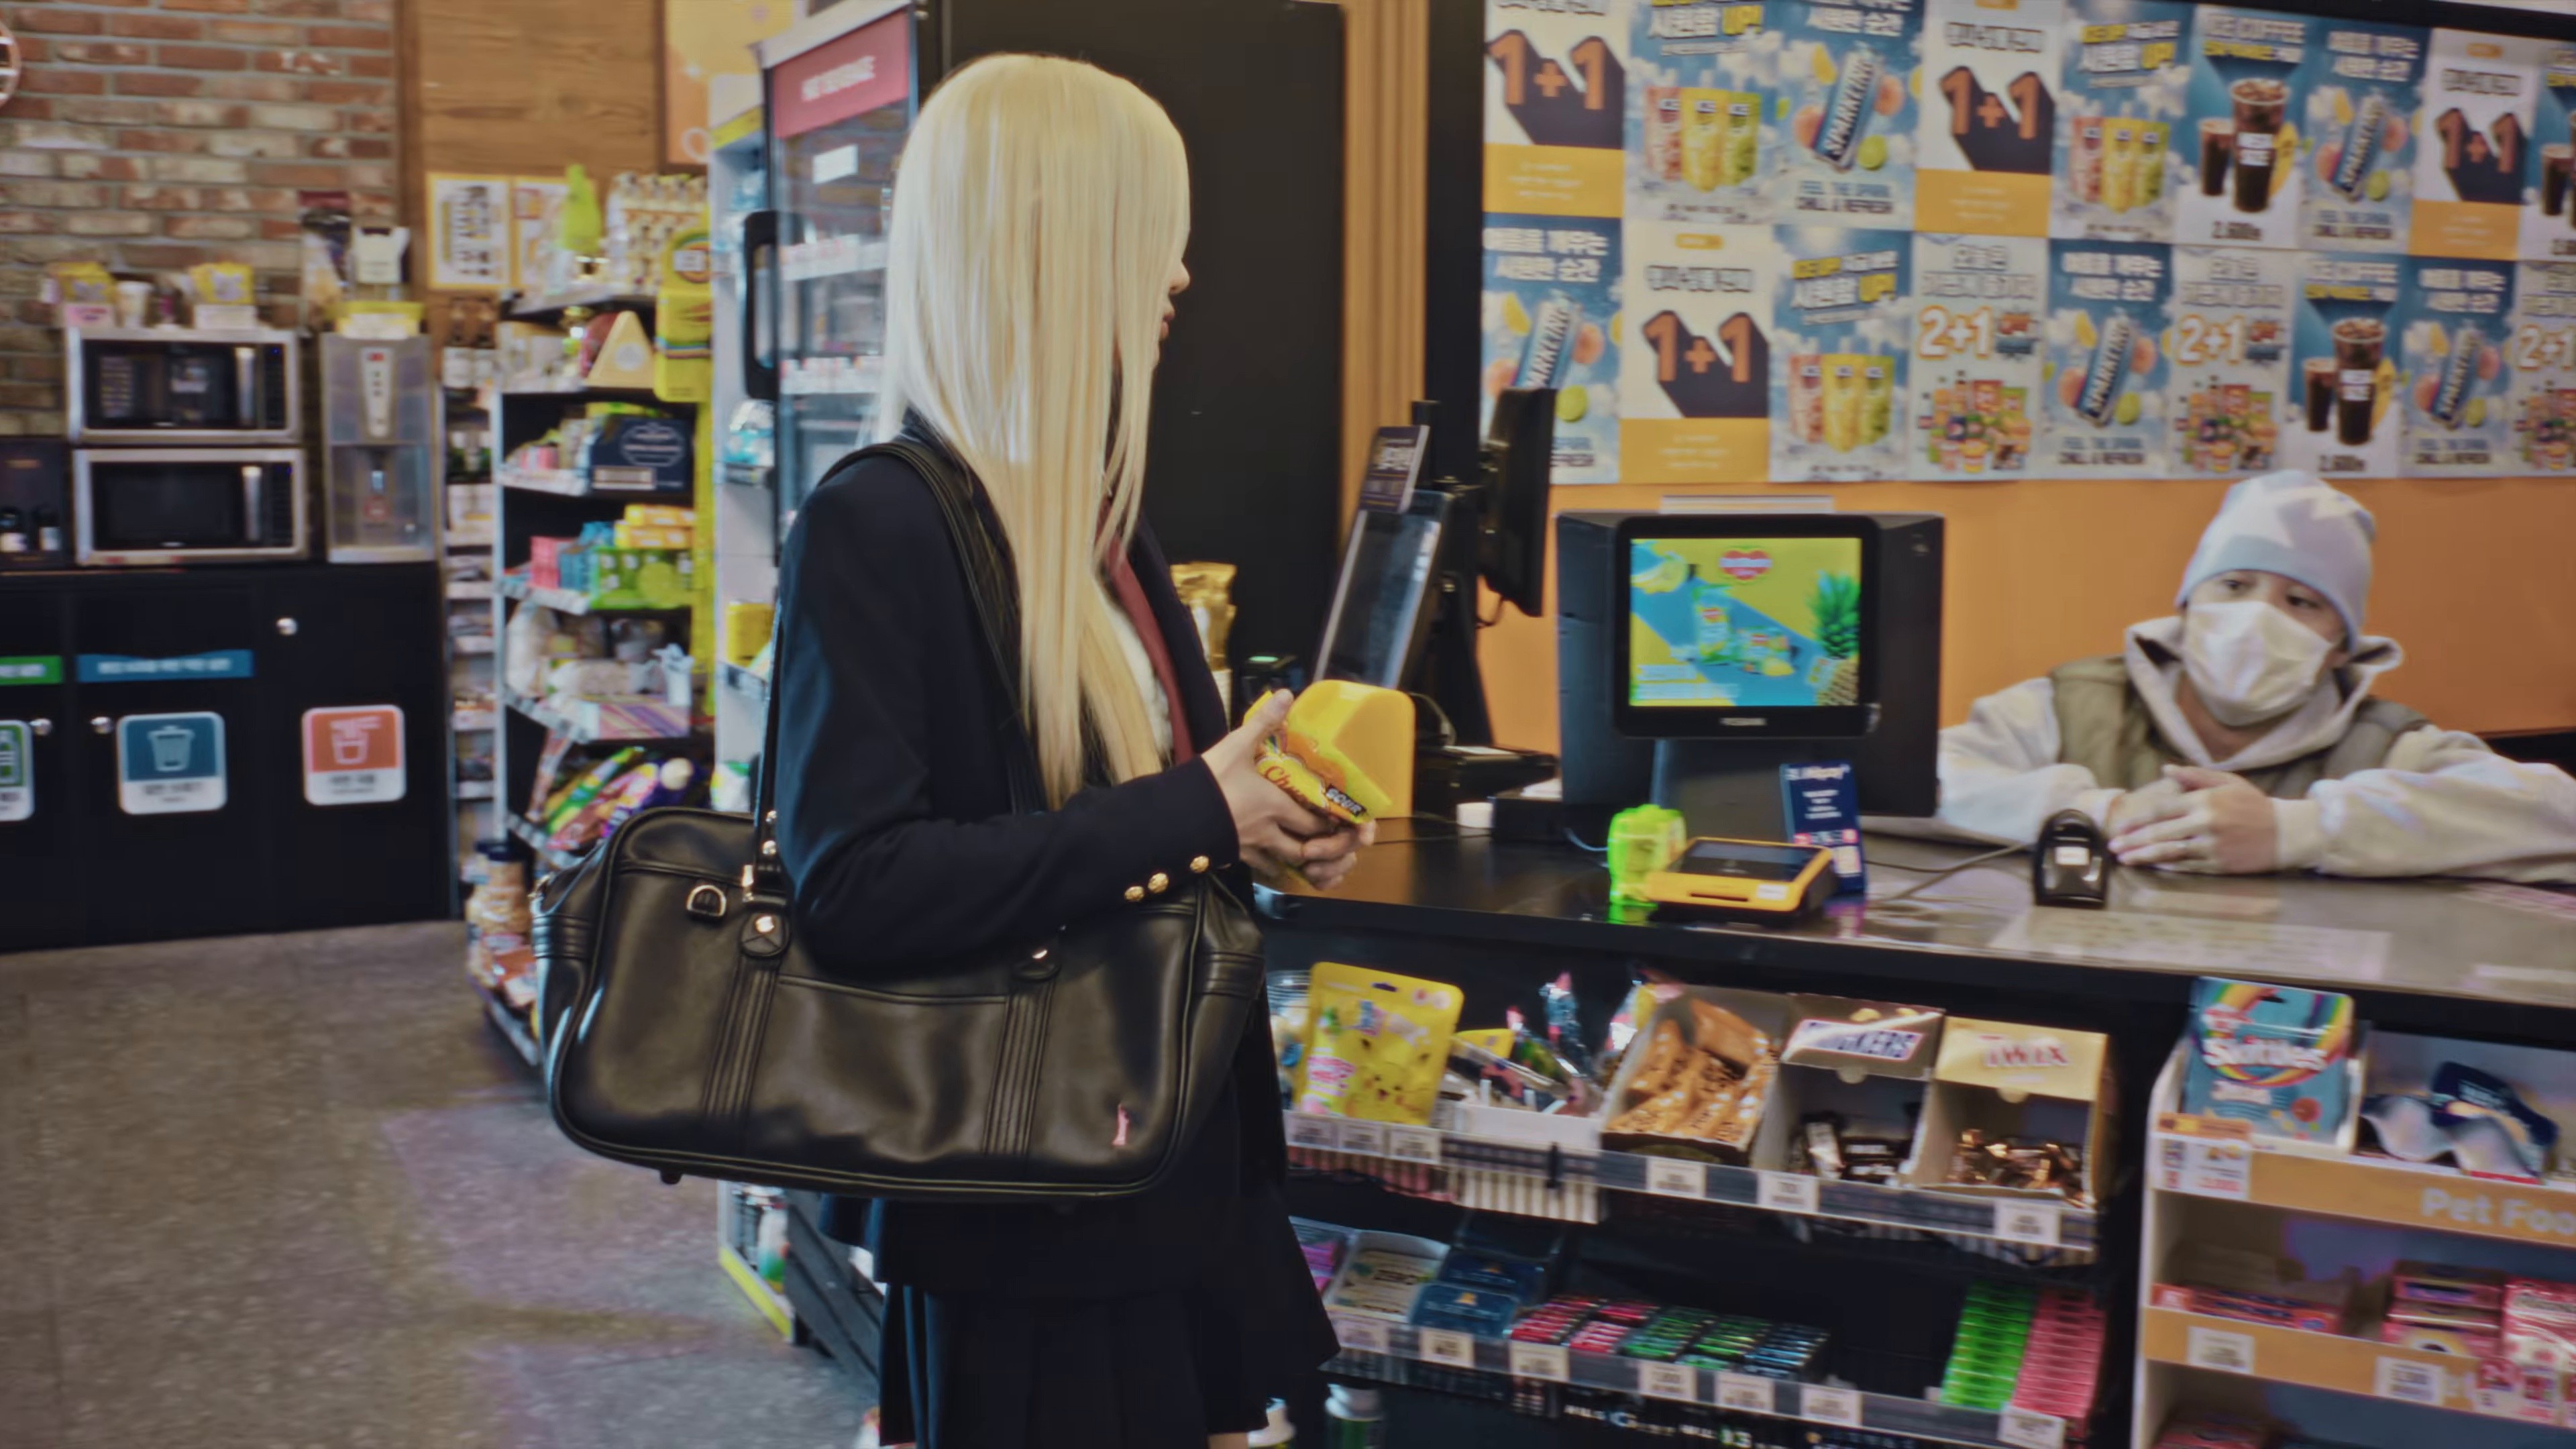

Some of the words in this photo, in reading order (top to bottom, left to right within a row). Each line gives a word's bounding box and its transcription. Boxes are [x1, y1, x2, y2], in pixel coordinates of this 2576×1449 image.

[1487, 30, 1606, 110] 1+1
[1939, 66, 2039, 140] 1+1
[1642, 311, 1753, 383] 1+1
[1919, 305, 1992, 361] 2+1
[2176, 314, 2245, 366] 2+1
[1326, 788, 1363, 814] SOUR
[2202, 1035, 2328, 1071] Skittles
[2420, 1187, 2491, 1224] Pet
